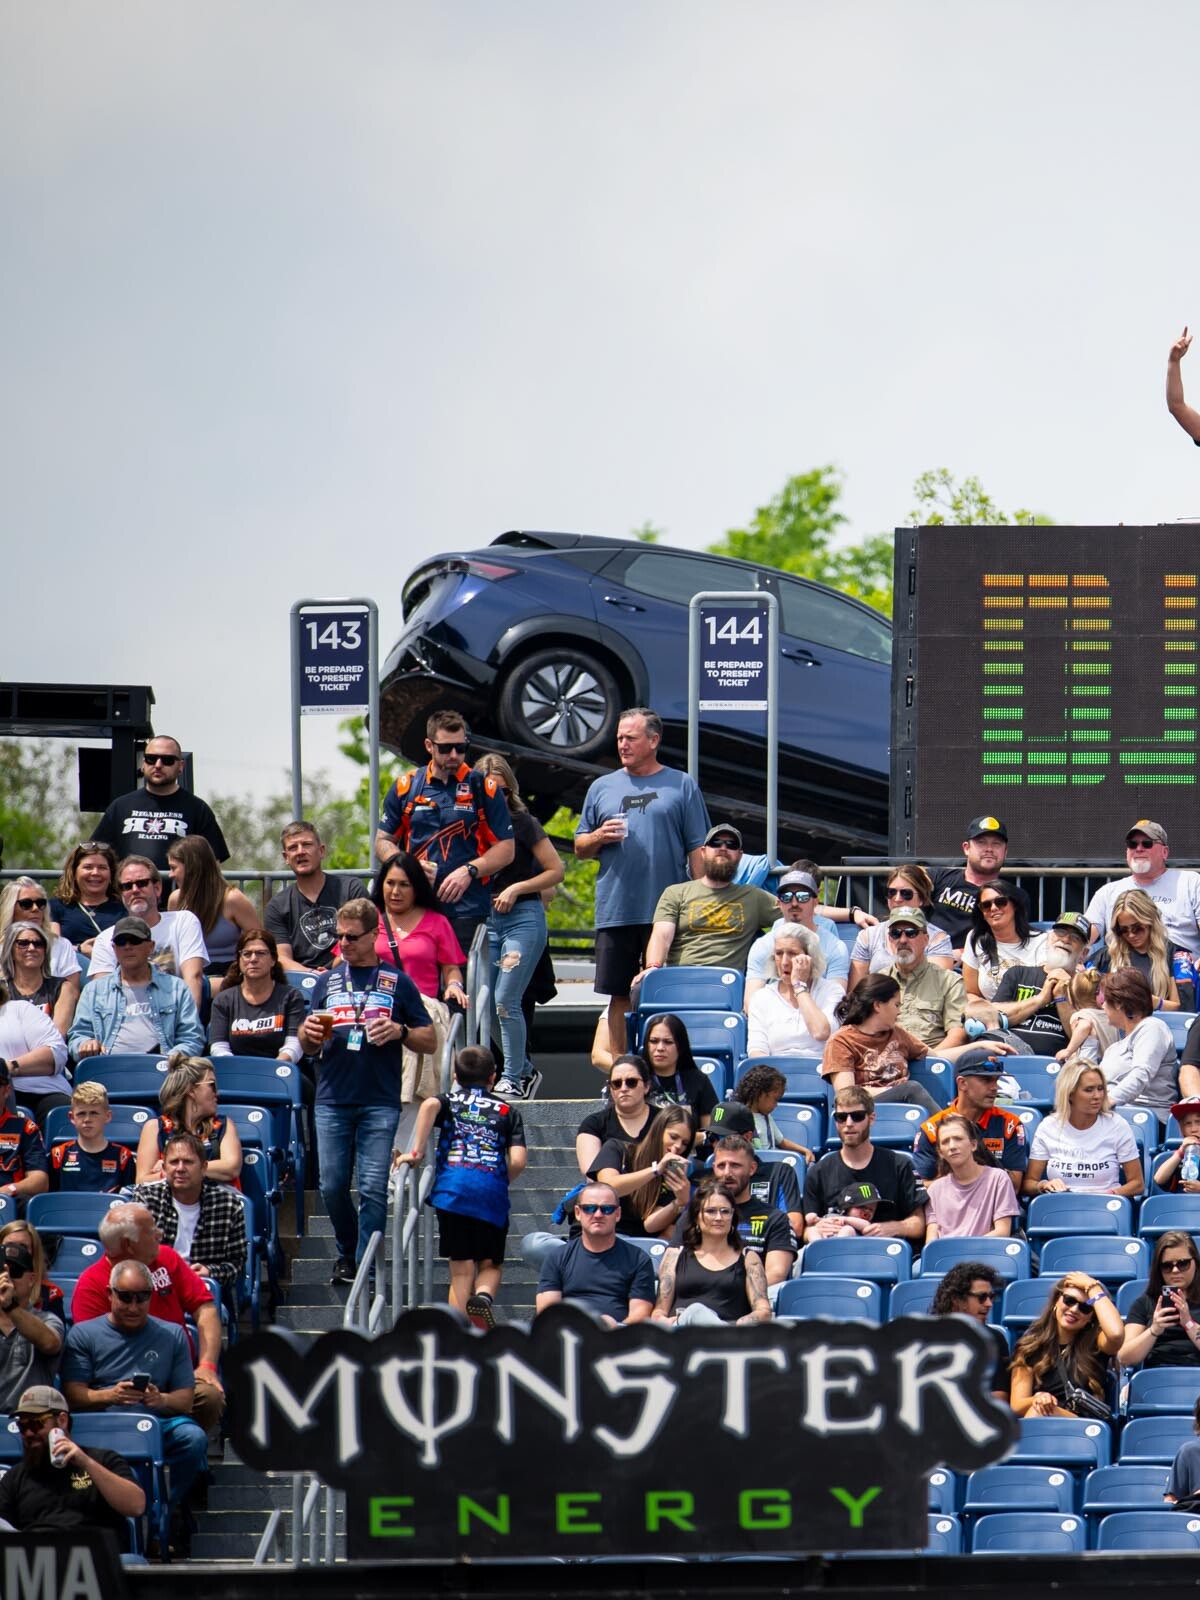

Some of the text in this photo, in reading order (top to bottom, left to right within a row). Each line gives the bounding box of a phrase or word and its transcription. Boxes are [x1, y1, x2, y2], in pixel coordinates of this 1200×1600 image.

[305, 621, 362, 650] 143
[704, 616, 762, 645] 144
[319, 683, 350, 691] TICKET
[1077, 1161, 1110, 1171] DROPS
[152, 1274, 172, 1291] FOX
[249, 1328, 998, 1467] MONSTER
[369, 1487, 882, 1538] ENERGY
[0, 1546, 102, 1600] MA
